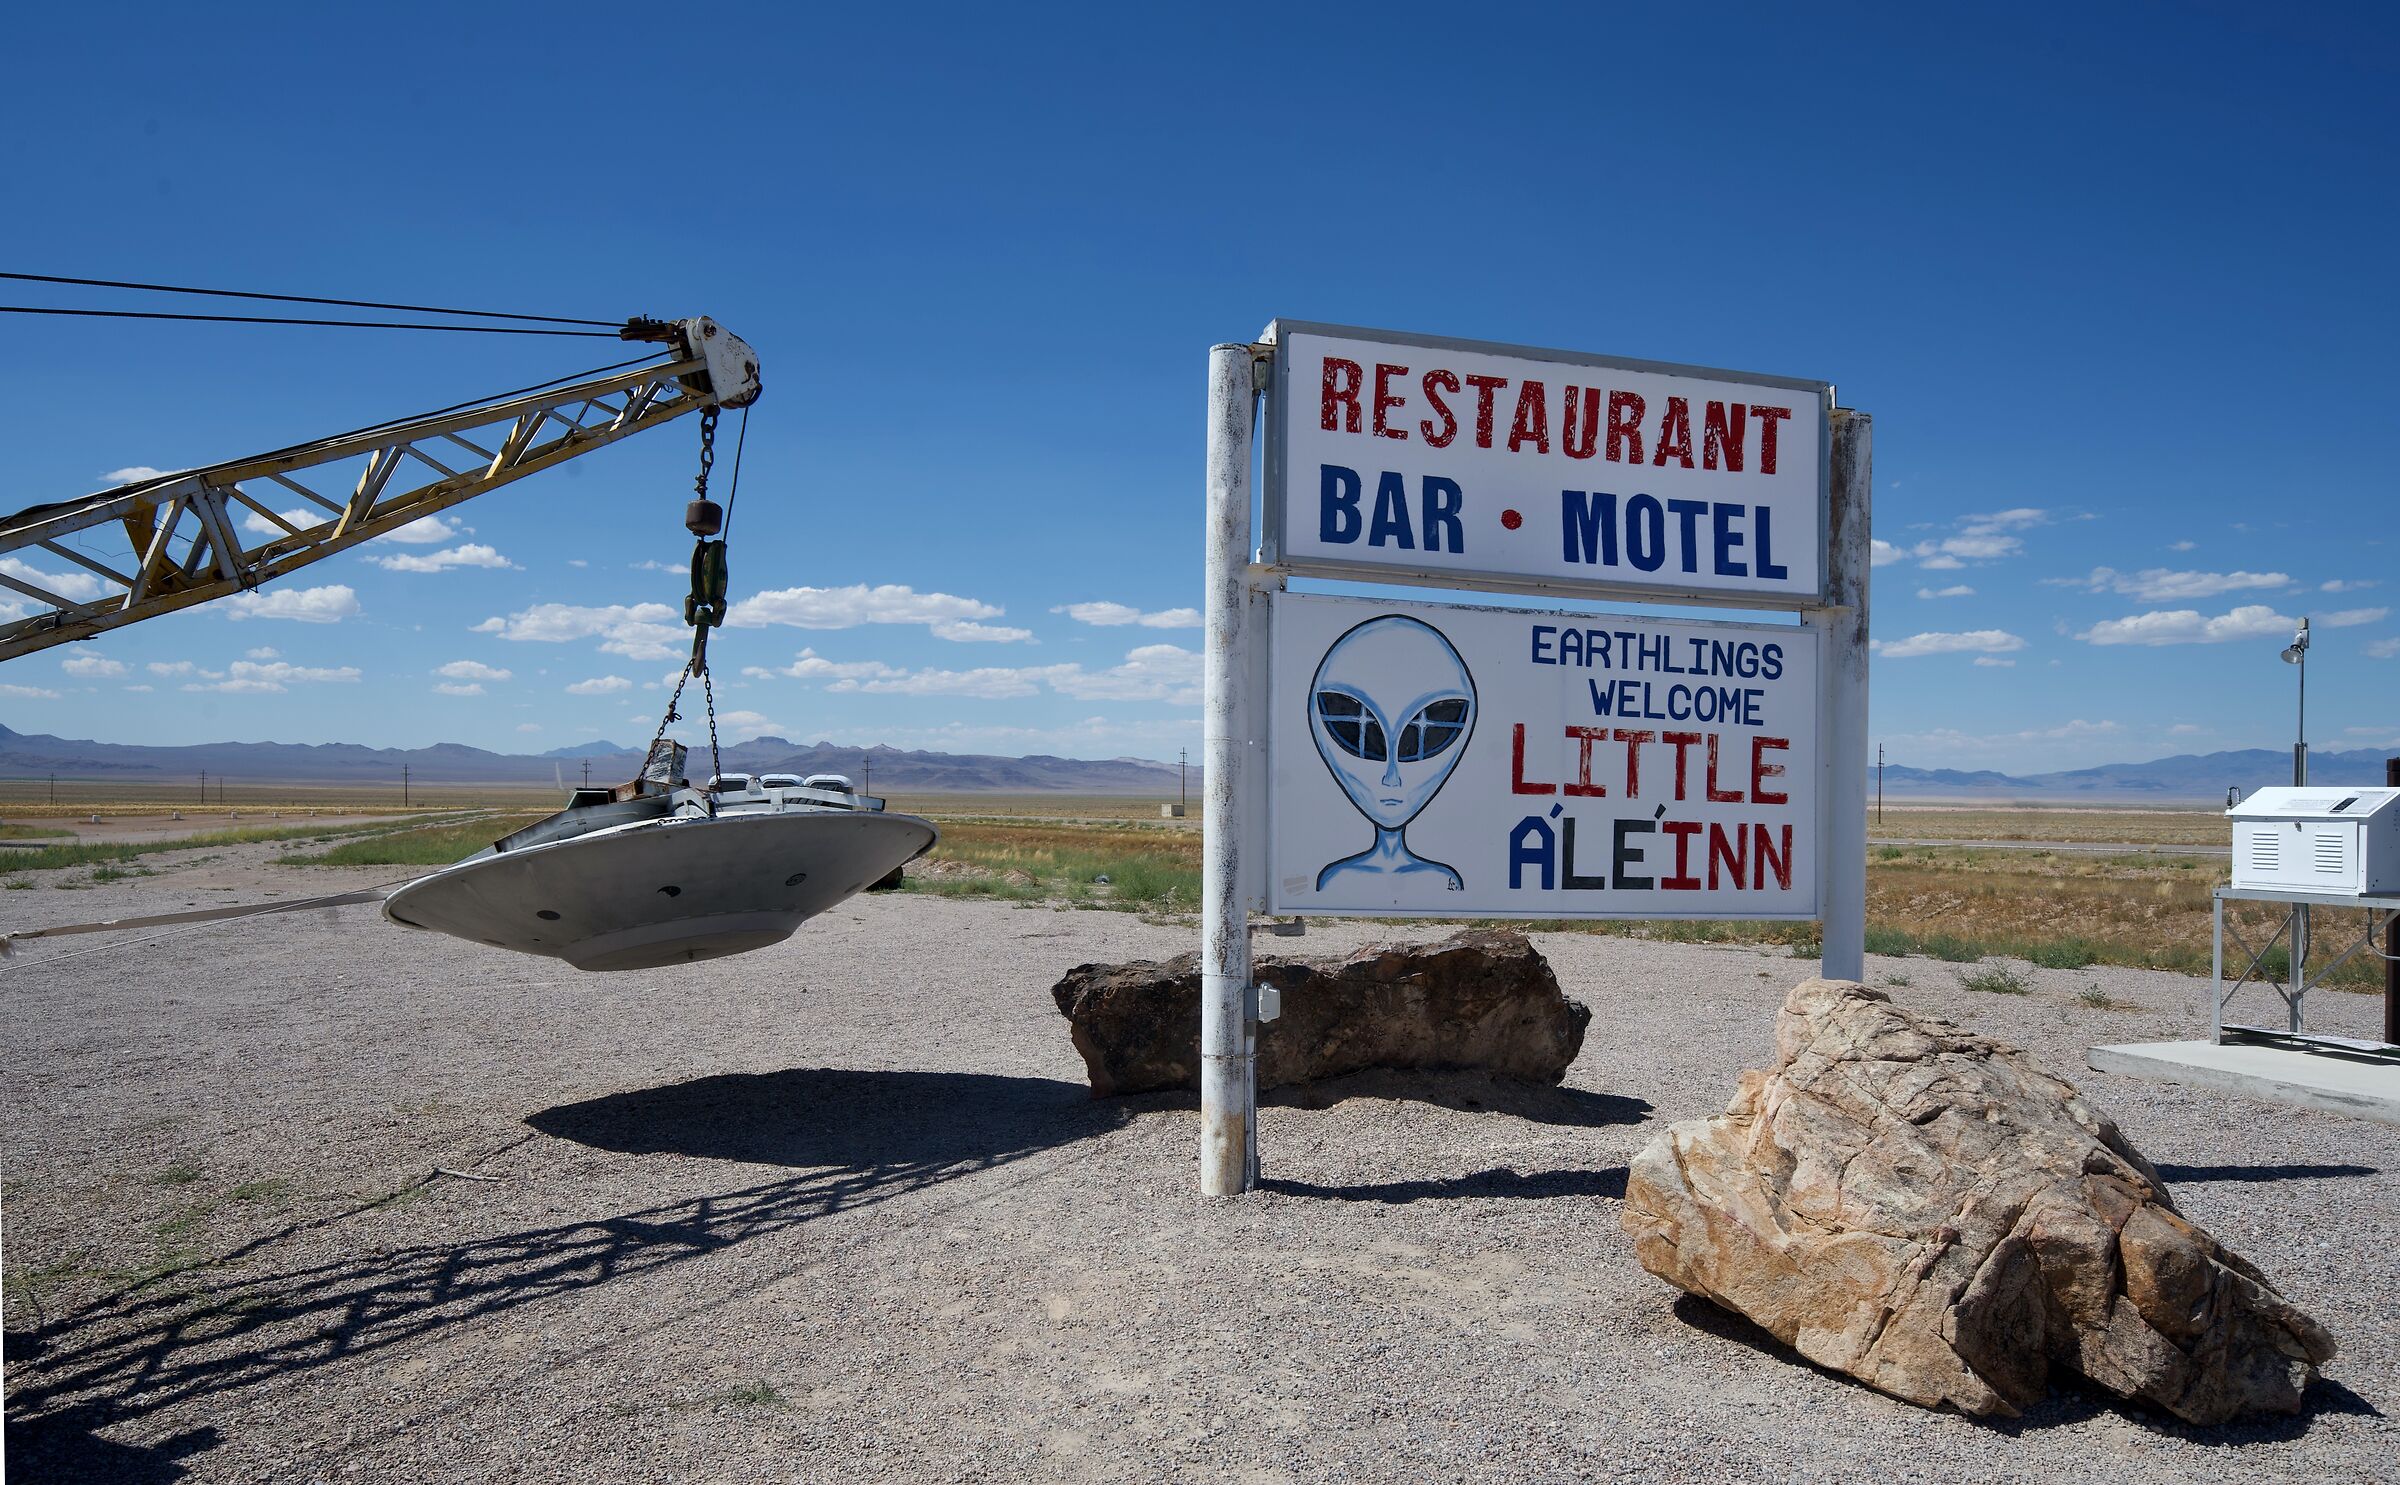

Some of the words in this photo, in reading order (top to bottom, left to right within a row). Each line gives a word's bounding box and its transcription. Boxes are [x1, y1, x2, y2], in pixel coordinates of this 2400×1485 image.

[1320, 356, 1792, 475] RESTAURANT
[1318, 463, 1465, 555] BAR
[1561, 489, 1788, 581] MOTEL
[1531, 624, 1784, 681] EARTHLINGS
[1587, 678, 1765, 727] WELCOME
[1511, 722, 1790, 805] LITTLE
